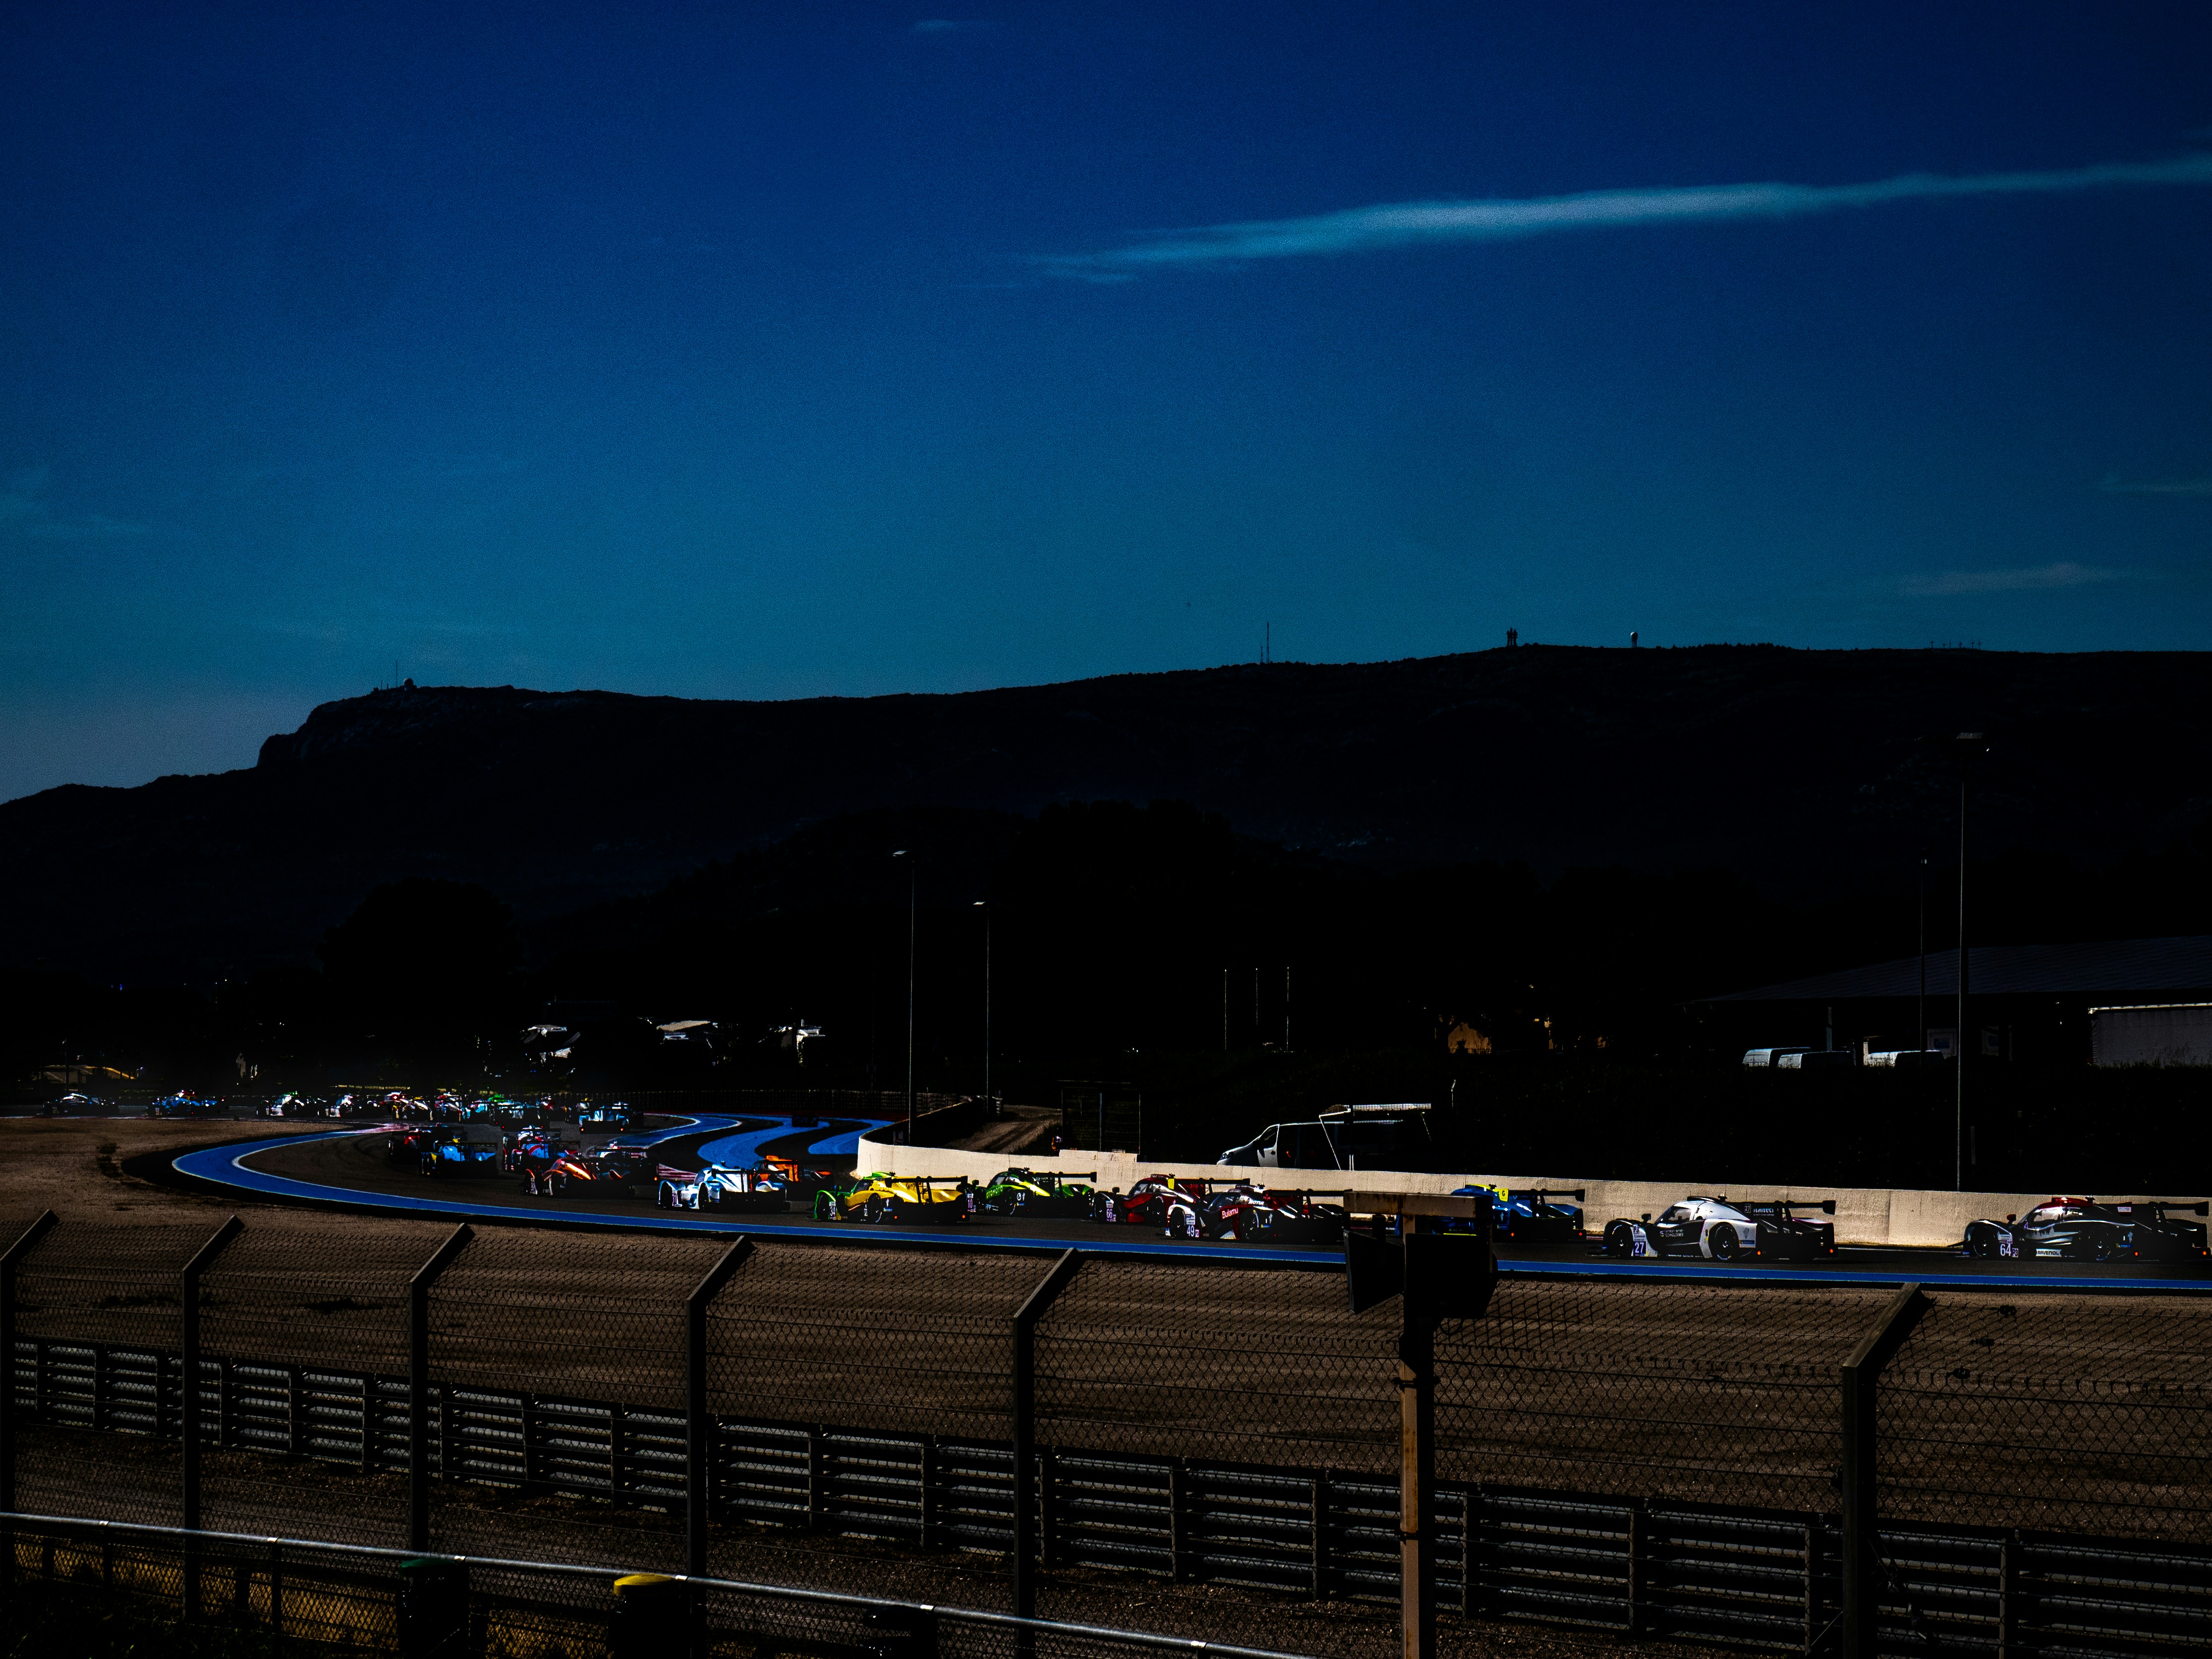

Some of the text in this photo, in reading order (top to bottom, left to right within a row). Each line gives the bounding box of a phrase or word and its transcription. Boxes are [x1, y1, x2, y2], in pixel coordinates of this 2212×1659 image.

[986, 1185, 1003, 1199] OTOMOTO
[968, 1199, 973, 1208] 10
[830, 1206, 836, 1216] 34
[1106, 1208, 1113, 1218] 66
[1222, 1208, 1239, 1219] Bulamu
[1187, 1225, 1194, 1237] 49
[1635, 1242, 1645, 1254] 27
[2000, 1244, 2011, 1257] 64
